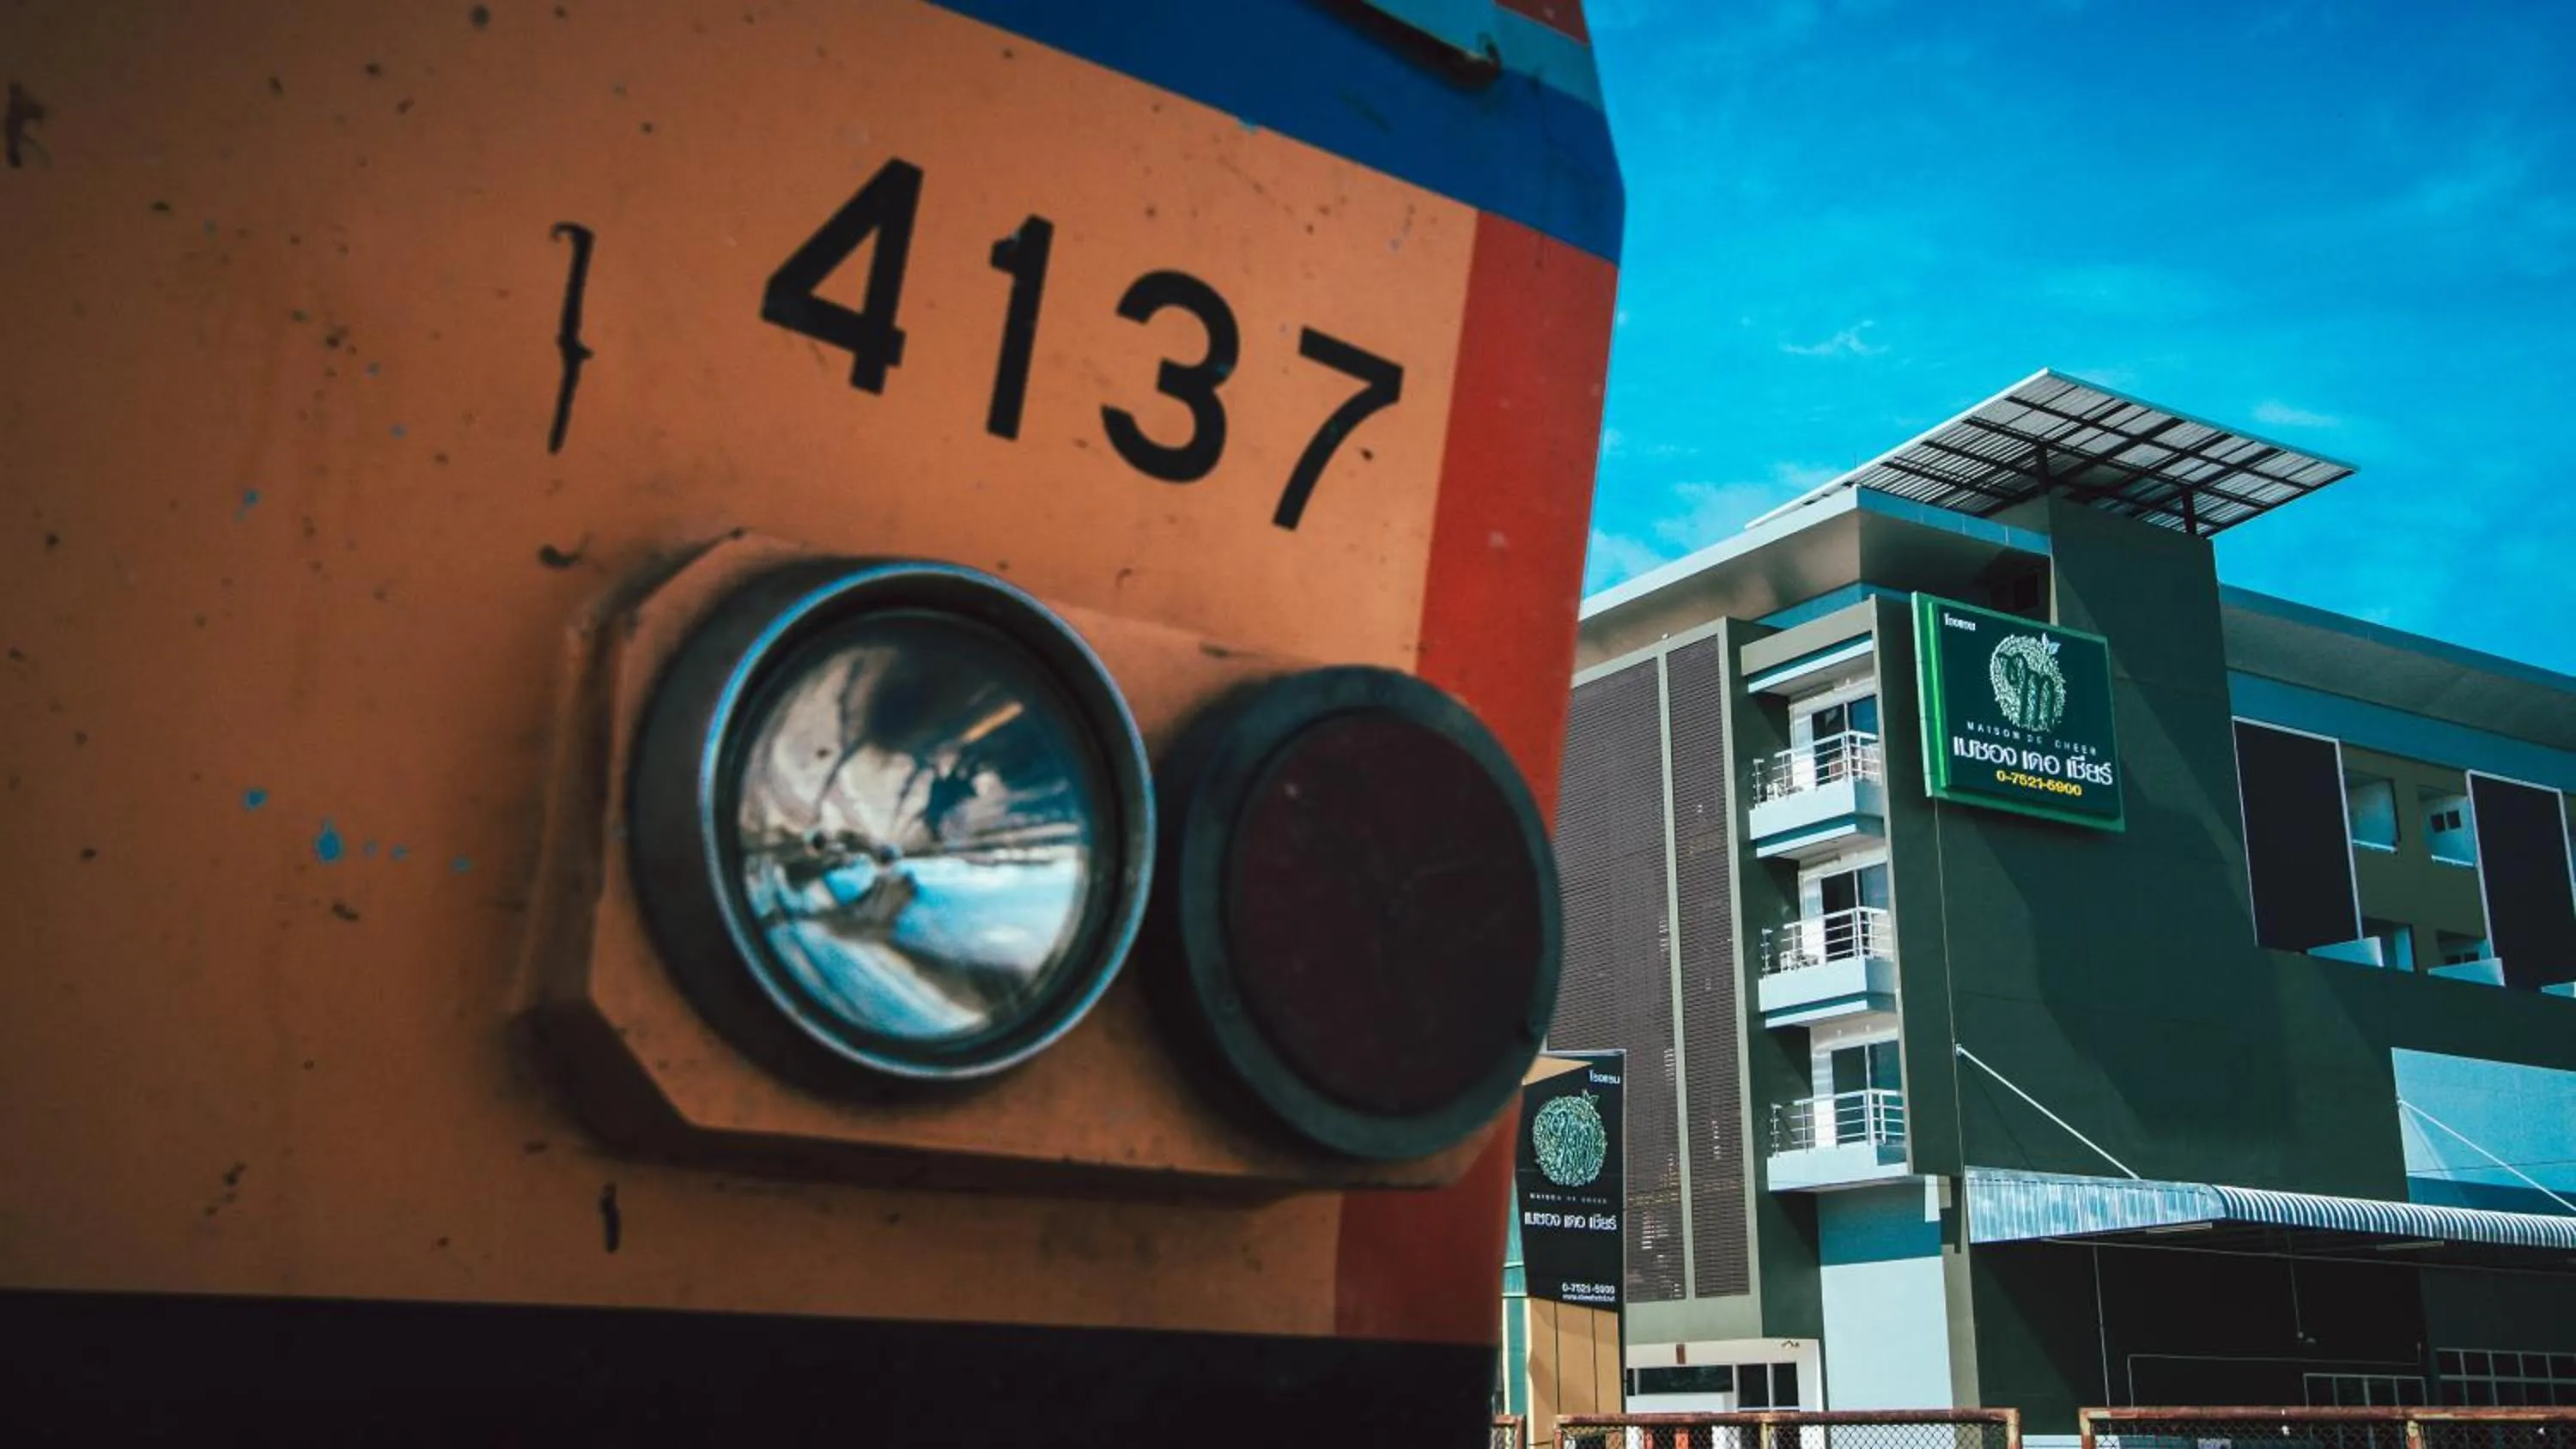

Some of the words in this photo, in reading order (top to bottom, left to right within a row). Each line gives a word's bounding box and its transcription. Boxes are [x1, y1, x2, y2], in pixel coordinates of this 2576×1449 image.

[759, 156, 1404, 530] 4137
[1966, 720, 2020, 740] MAISON
[2027, 734, 2043, 744] DE
[2021, 749, 2061, 775] เดอ
